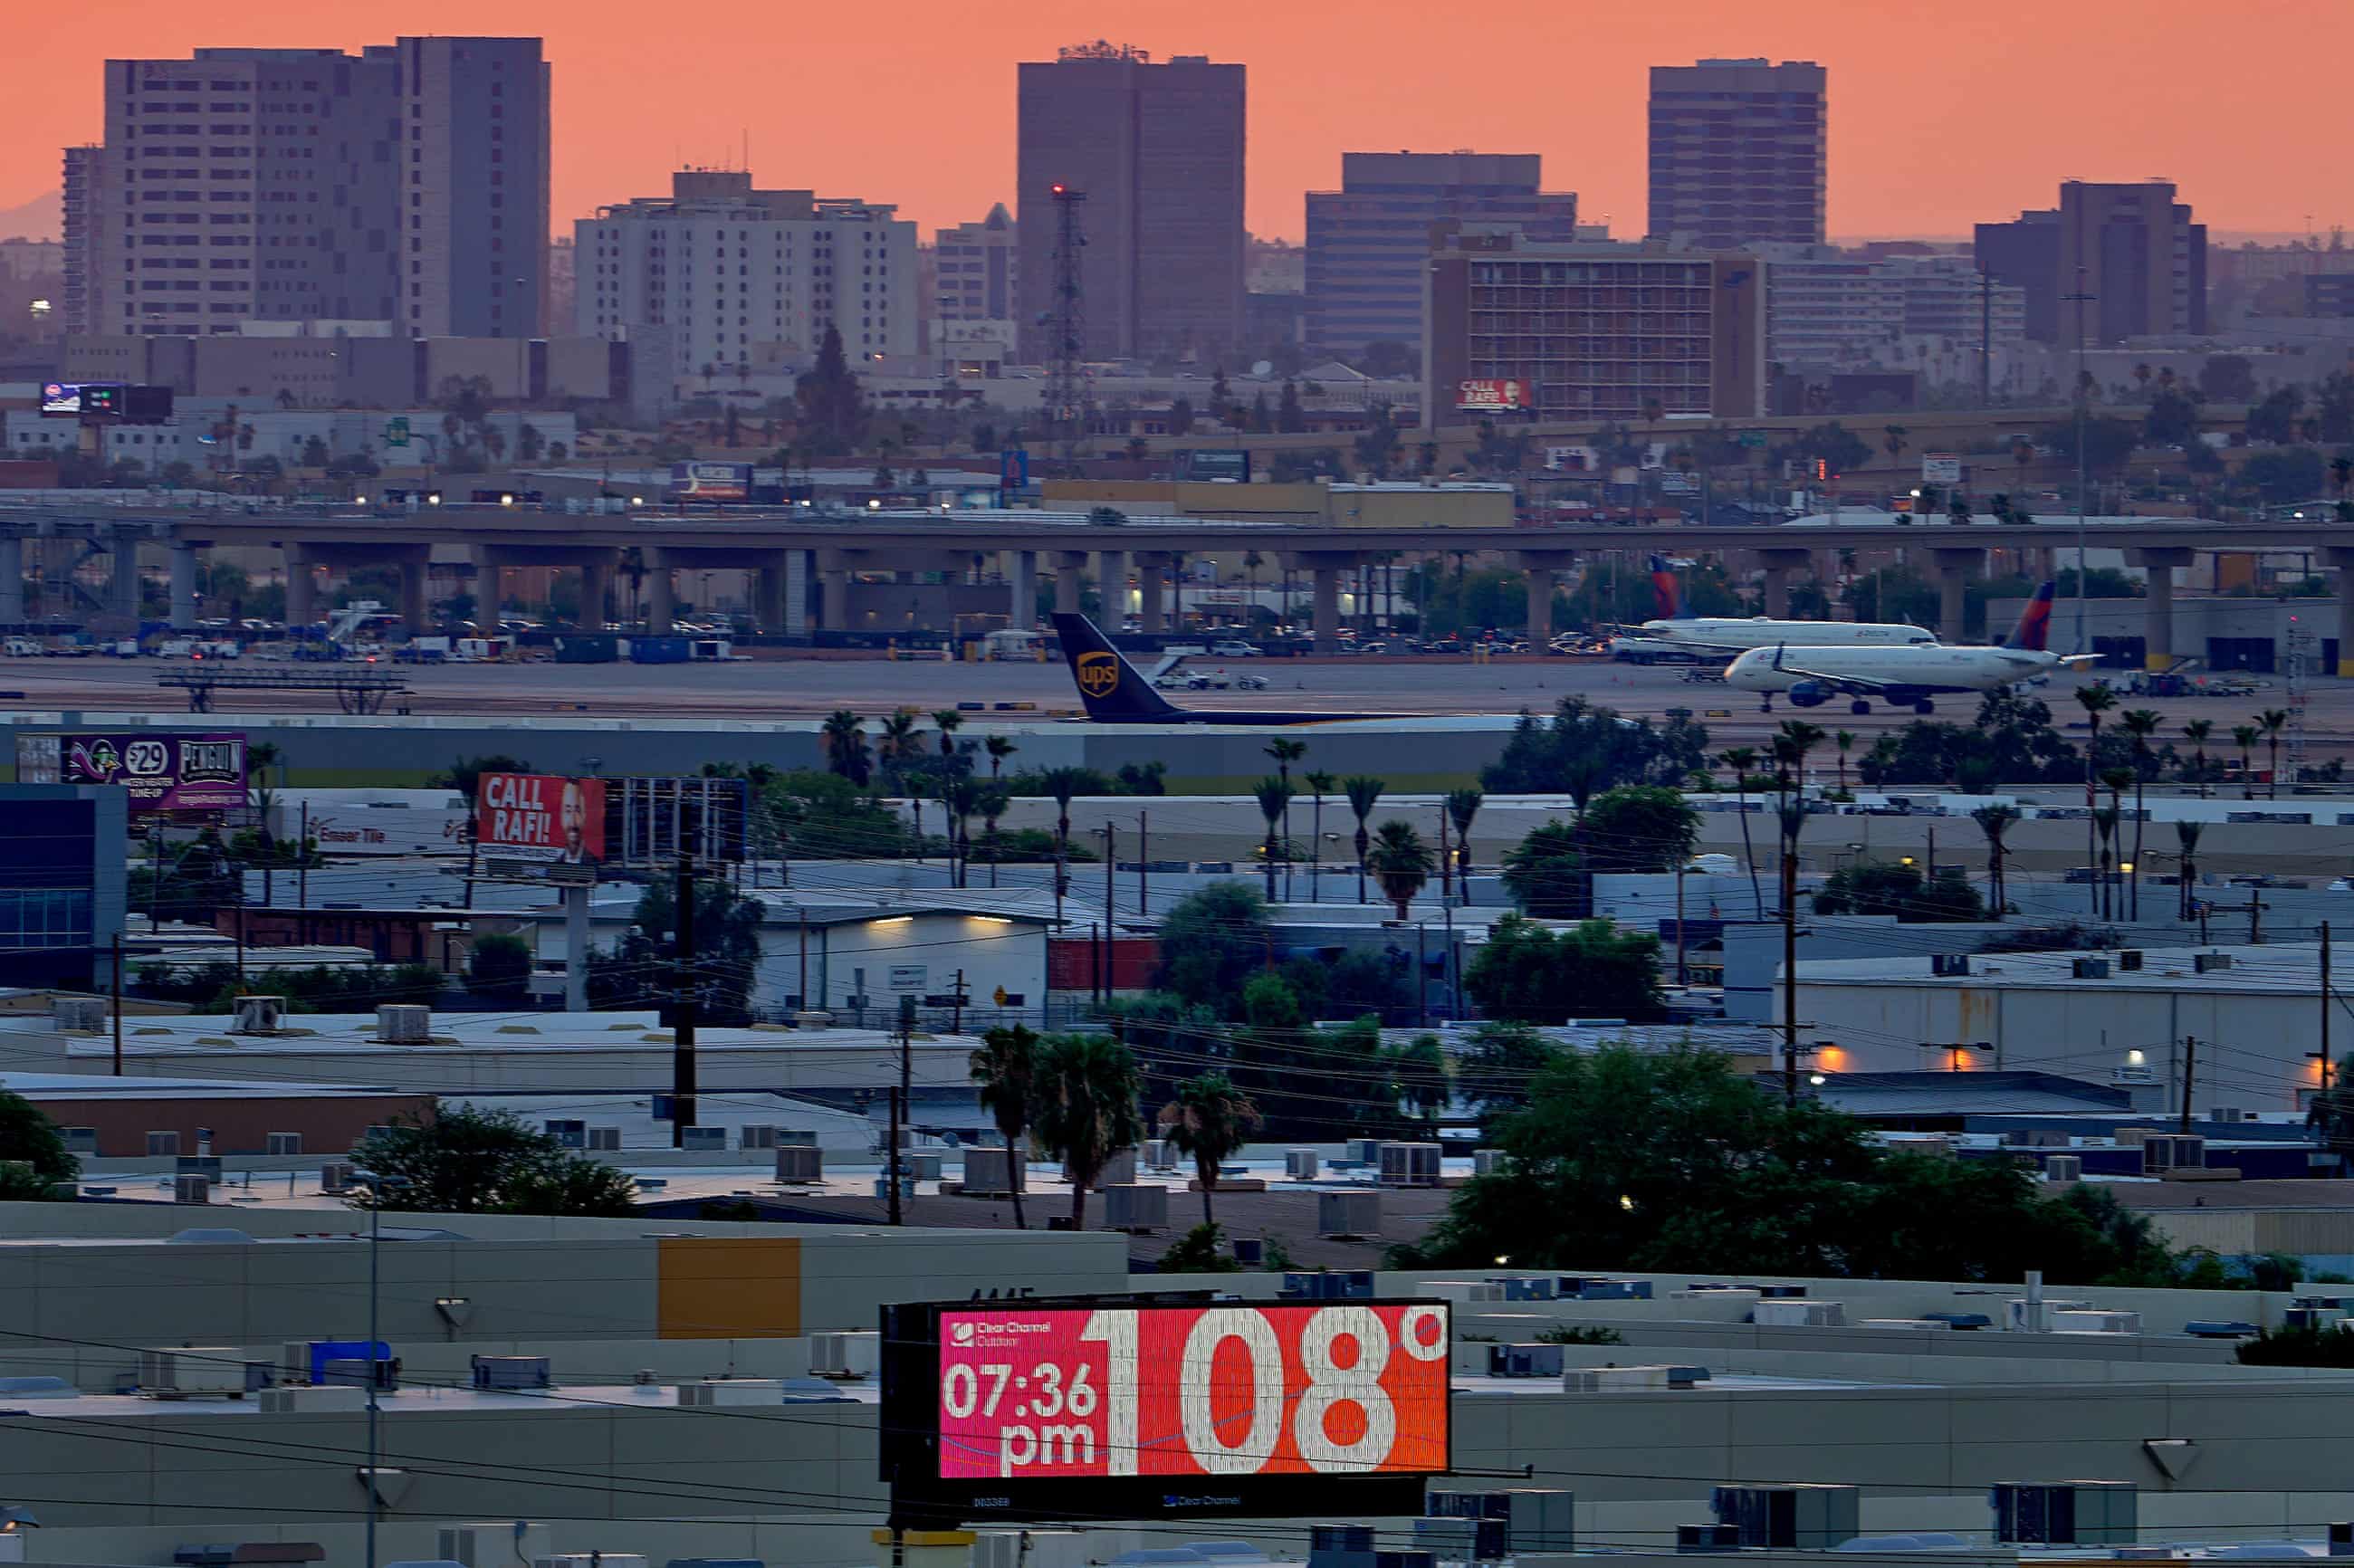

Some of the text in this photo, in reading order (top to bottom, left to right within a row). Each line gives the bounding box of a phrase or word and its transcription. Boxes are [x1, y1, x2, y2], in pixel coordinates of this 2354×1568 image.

[1079, 665, 1116, 689] ups
[129, 744, 163, 768] $29
[180, 742, 241, 773] PENGUIN
[486, 777, 544, 810] CALL
[361, 827, 386, 843] Tile
[493, 810, 551, 842] RAFI!
[977, 1321, 1051, 1334] Clear Channel
[943, 1362, 1097, 1419] 07:36
[1000, 1424, 1096, 1477] pm
